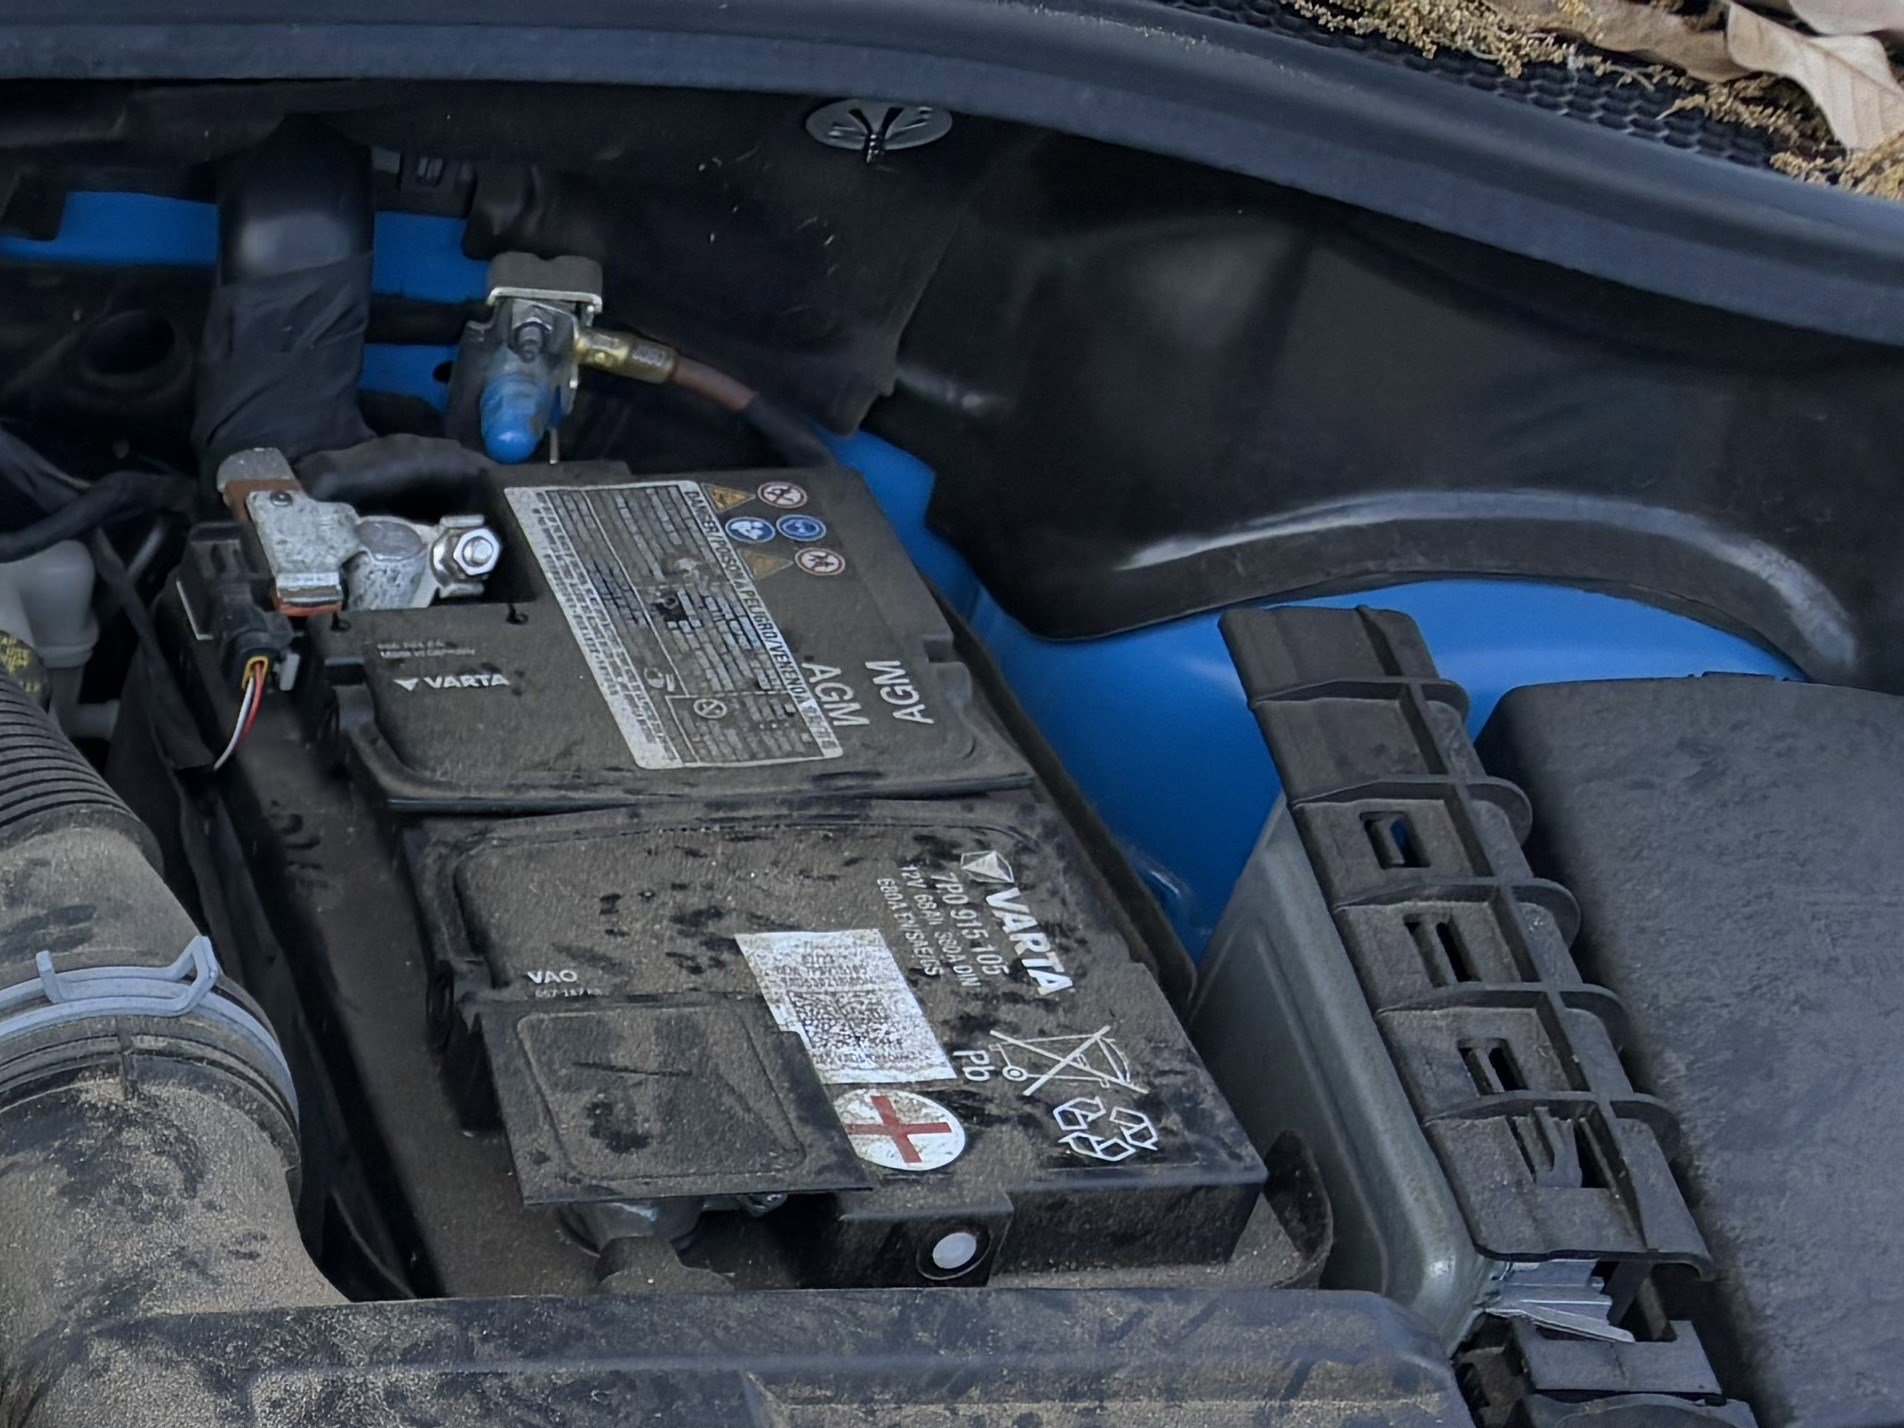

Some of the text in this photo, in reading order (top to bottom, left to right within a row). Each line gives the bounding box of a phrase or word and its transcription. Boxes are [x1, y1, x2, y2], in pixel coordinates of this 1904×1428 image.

[423, 673, 510, 689] VARTA
[801, 662, 871, 727] AGM
[864, 660, 935, 725] AGM
[899, 864, 929, 890] 12V
[950, 908, 990, 941] 915
[971, 945, 1012, 978] 105
[985, 886, 1074, 996] VARTA
[952, 1049, 997, 1083] Pb
